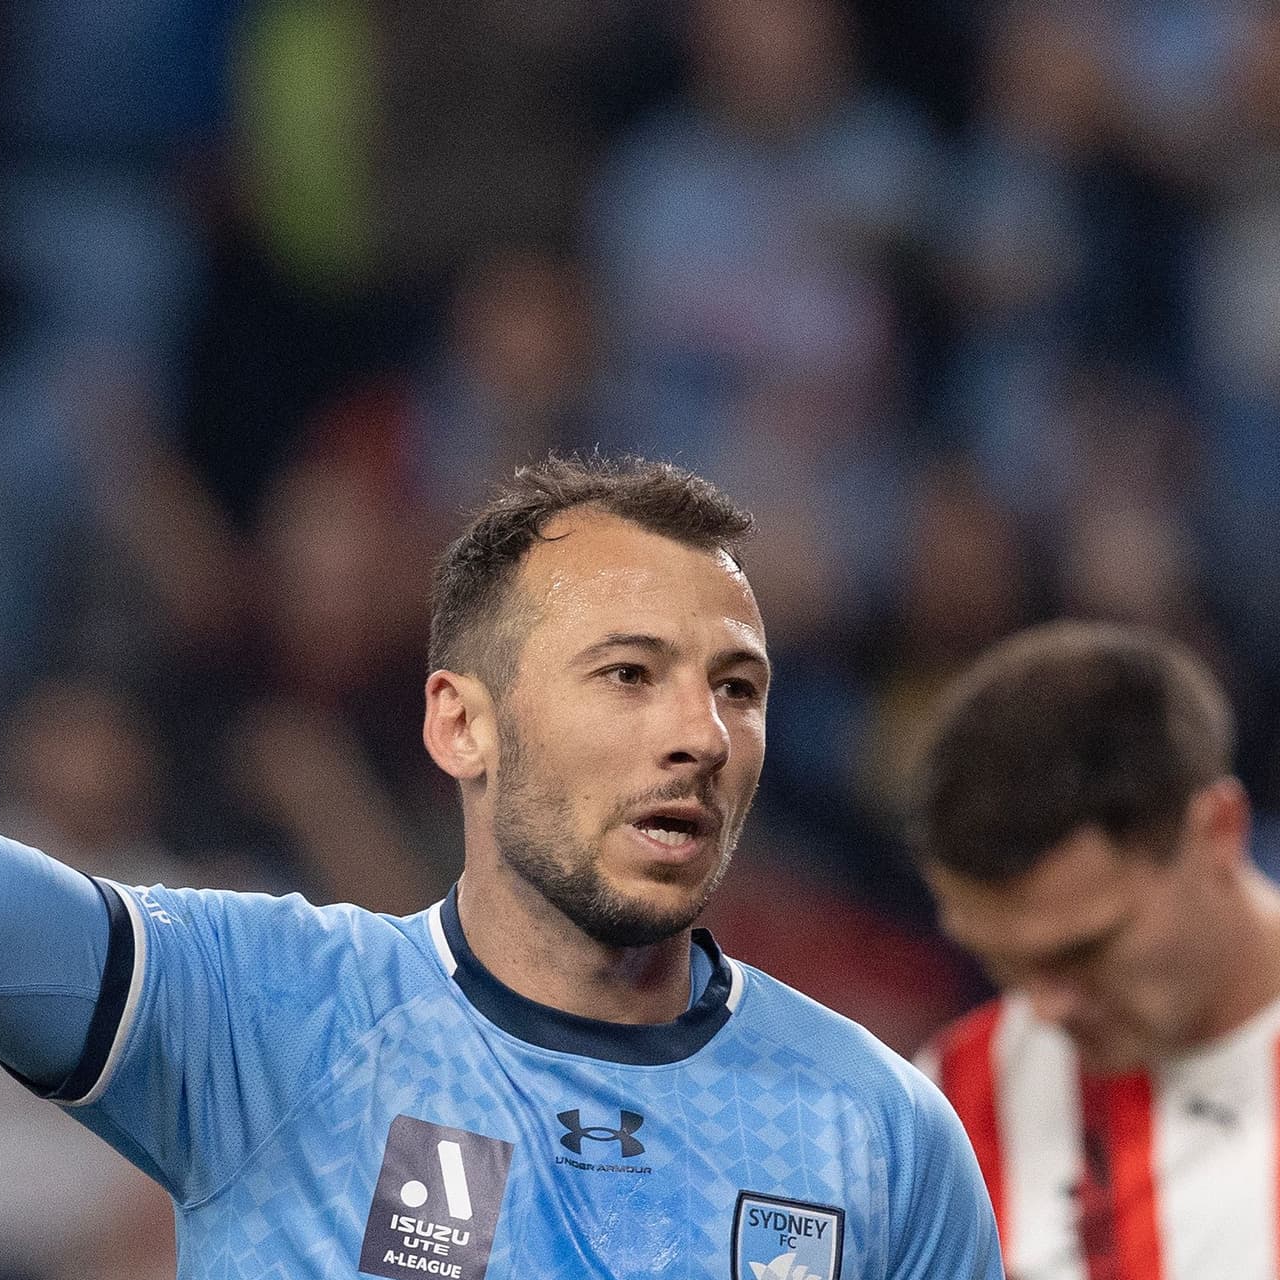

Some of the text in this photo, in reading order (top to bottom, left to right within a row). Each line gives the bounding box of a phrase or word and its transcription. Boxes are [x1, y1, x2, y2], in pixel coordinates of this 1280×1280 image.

[555, 1156, 652, 1175] UNDER ARMOUR
[390, 1214, 470, 1246] ISUZU
[749, 1208, 828, 1240] SYDNEY
[403, 1236, 450, 1256] UTE
[780, 1233, 797, 1249] FC
[383, 1249, 462, 1279] A-LEAGUE
